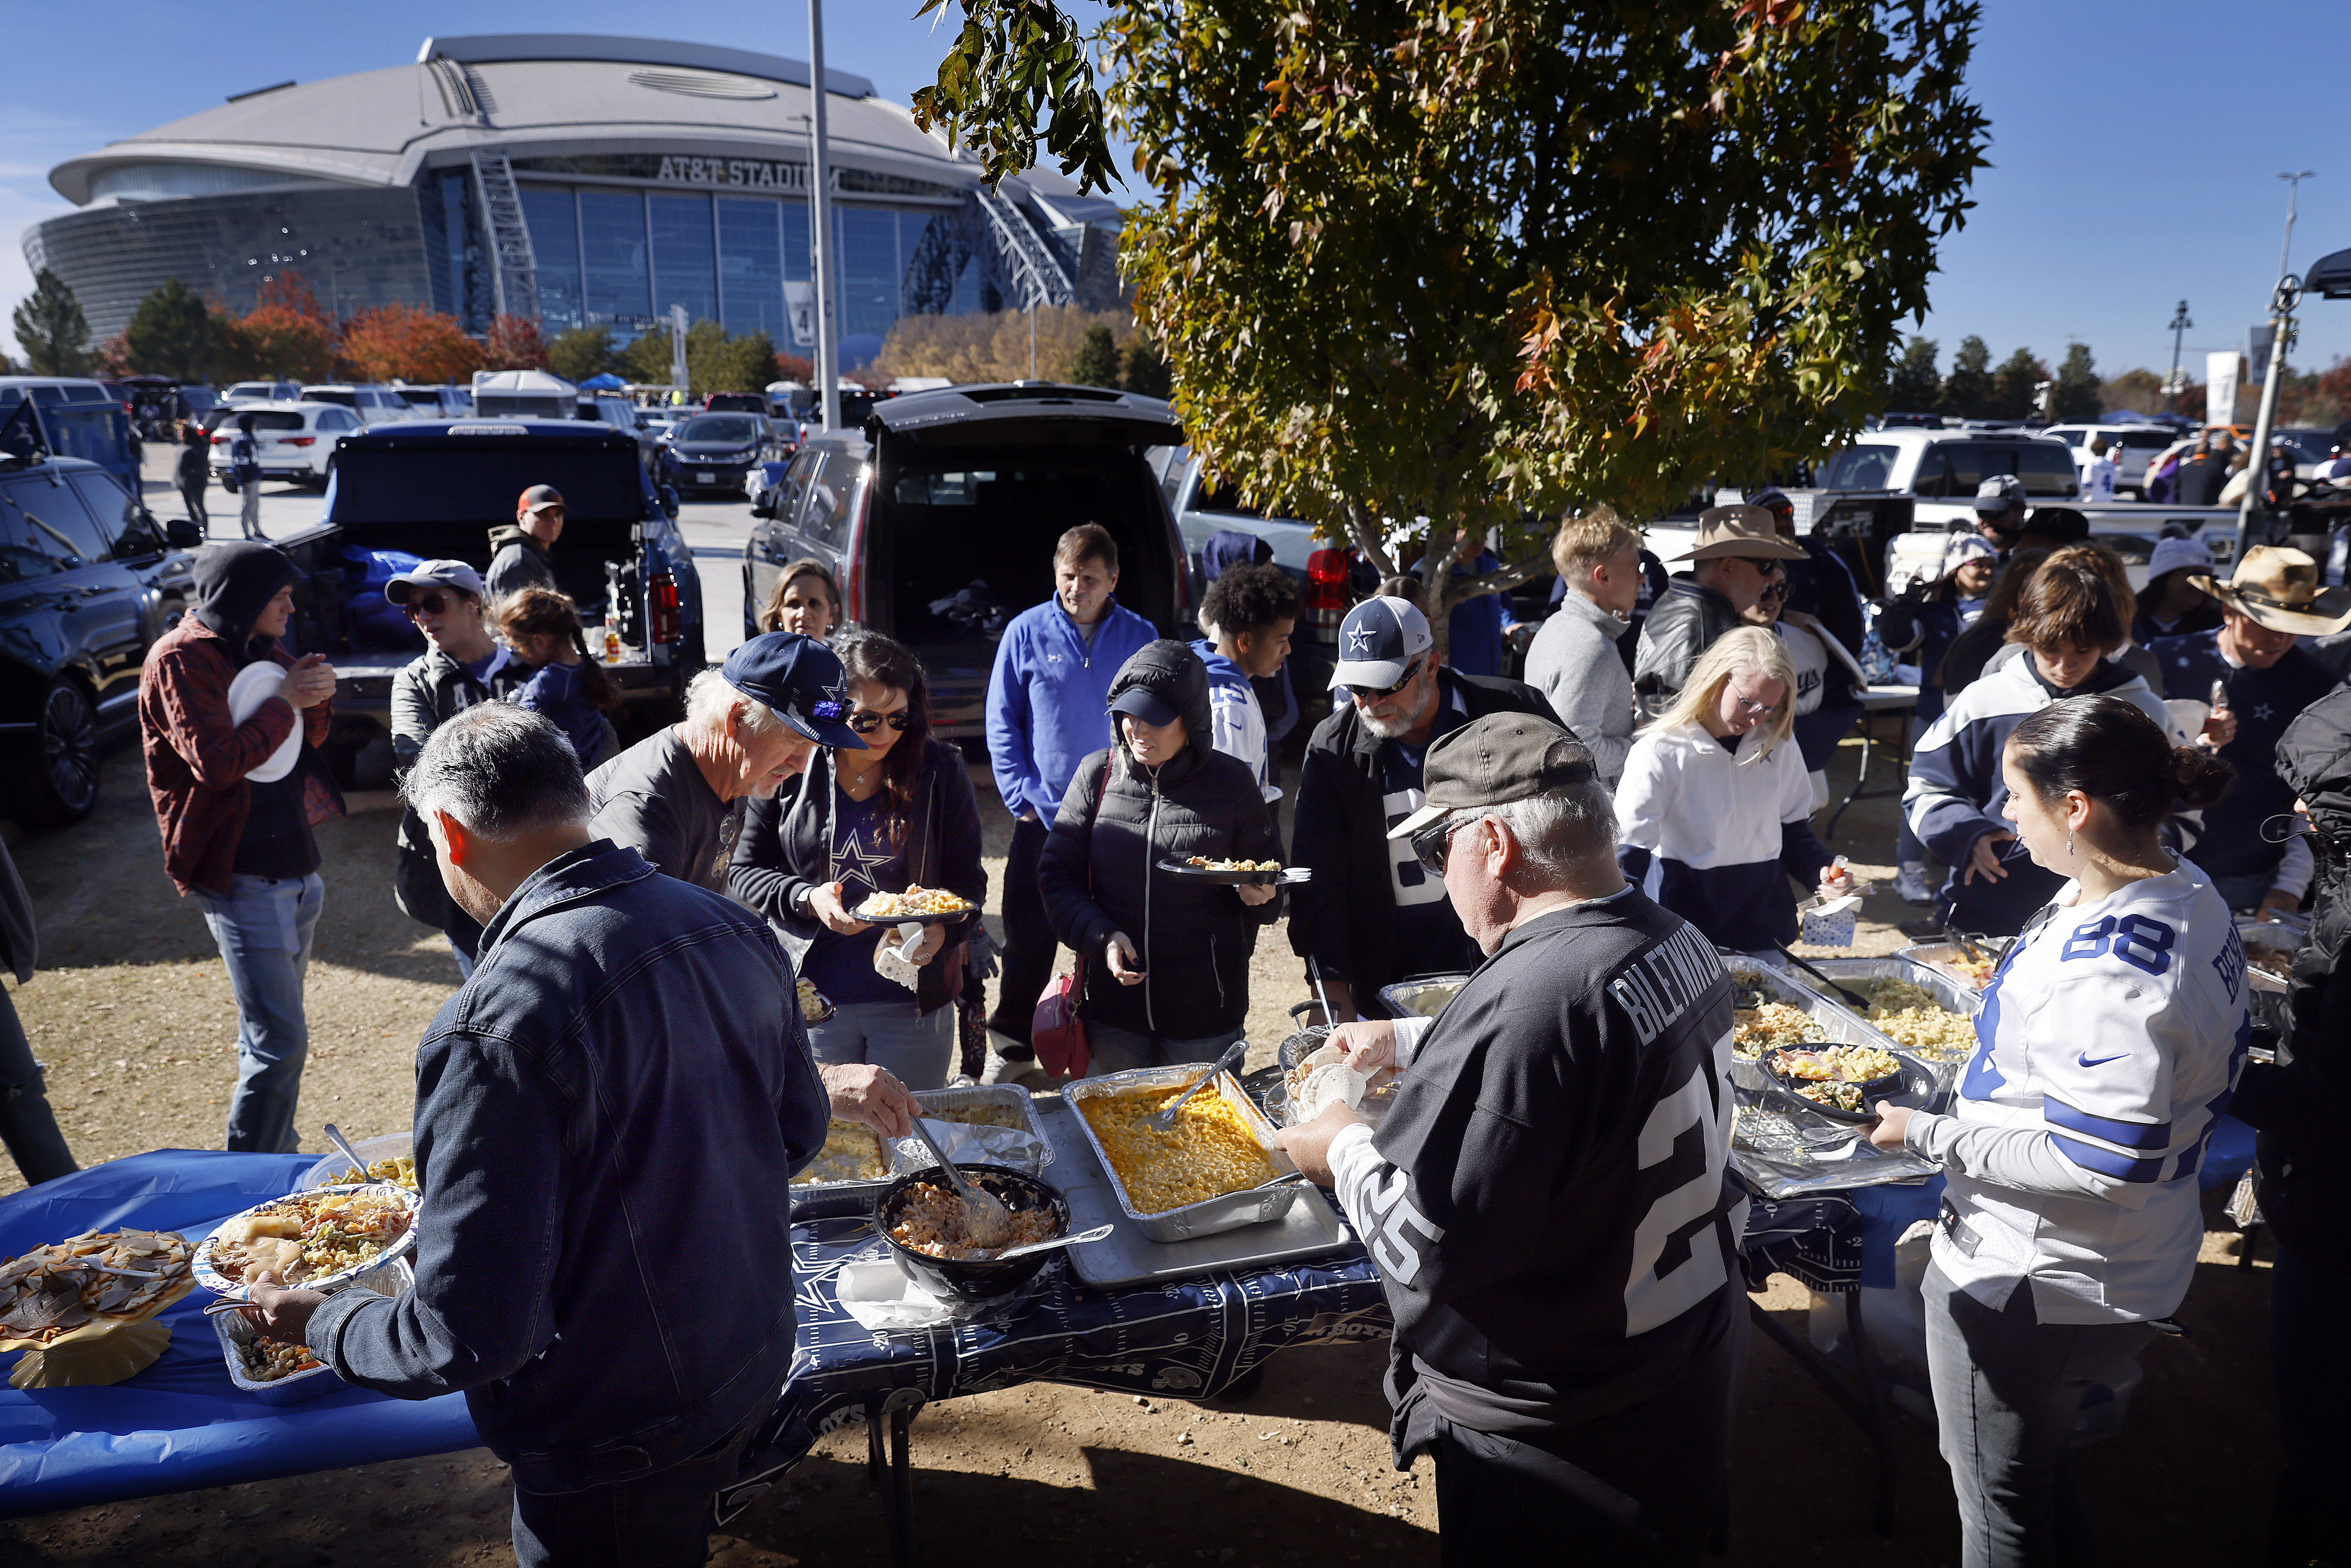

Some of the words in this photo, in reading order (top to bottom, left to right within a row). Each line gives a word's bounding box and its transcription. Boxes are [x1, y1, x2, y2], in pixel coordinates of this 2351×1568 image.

[658, 156, 722, 183] AT&T
[2060, 914, 2176, 976] 88
[1360, 1166, 1446, 1286] 25
[1281, 1315, 1298, 1332] 10
[872, 1330, 890, 1347] 20
